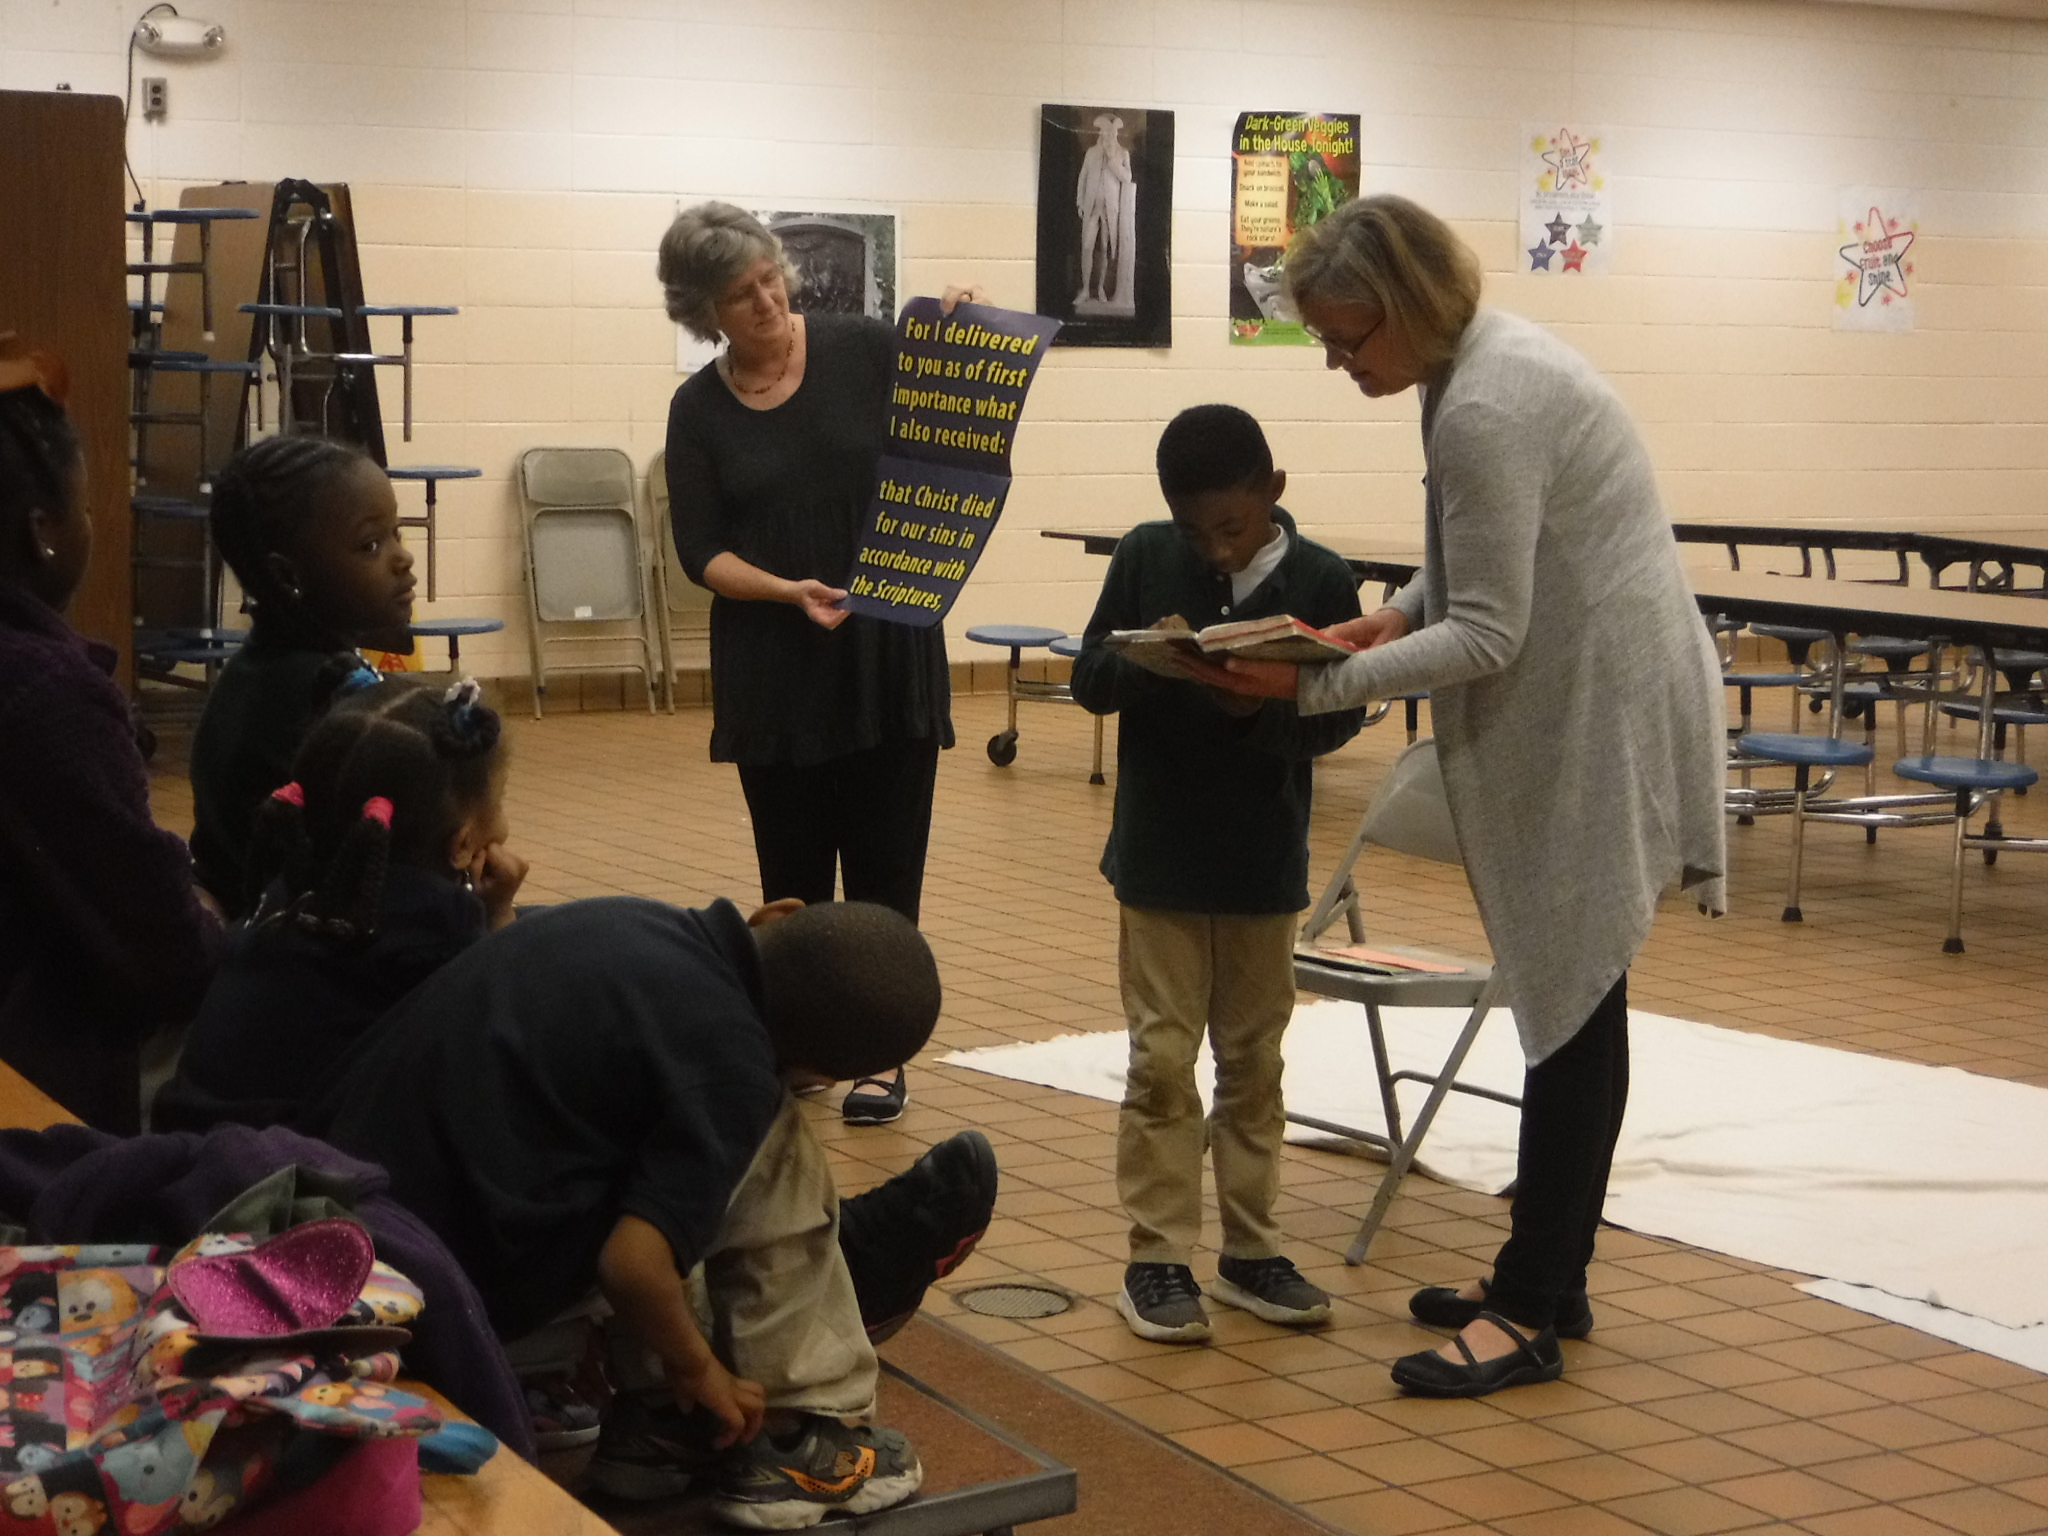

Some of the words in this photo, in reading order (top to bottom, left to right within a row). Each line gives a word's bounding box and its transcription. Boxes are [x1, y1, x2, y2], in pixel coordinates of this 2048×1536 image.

[1245, 115, 1305, 132] Dark-Green
[1308, 117, 1349, 137] Veggies
[1240, 134, 1250, 150] in
[1252, 134, 1270, 150] the
[1274, 135, 1307, 152] House
[1311, 138, 1353, 156] Tonight!
[1243, 169, 1256, 178] your
[1251, 218, 1262, 226] your
[1863, 239, 1892, 254] Choose
[905, 317, 930, 340] For
[934, 321, 941, 341] I
[945, 323, 1037, 356] delivered
[899, 351, 913, 372] to
[917, 357, 942, 380] you
[945, 360, 961, 378] as
[965, 359, 983, 382] of
[986, 362, 1028, 388] first
[893, 382, 971, 415] importance
[976, 394, 1017, 421] what
[890, 416, 896, 437] I
[900, 418, 930, 443] also
[935, 423, 1006, 454] received:
[880, 479, 912, 504] that
[914, 484, 958, 513] Christ
[961, 492, 995, 519] died
[876, 512, 898, 534] for
[901, 520, 926, 540] our
[928, 523, 958, 545] sins
[961, 527, 975, 549] in
[859, 546, 932, 575] accordance
[934, 555, 966, 580] with
[850, 574, 872, 596] the
[873, 578, 943, 612] Scriptures,
